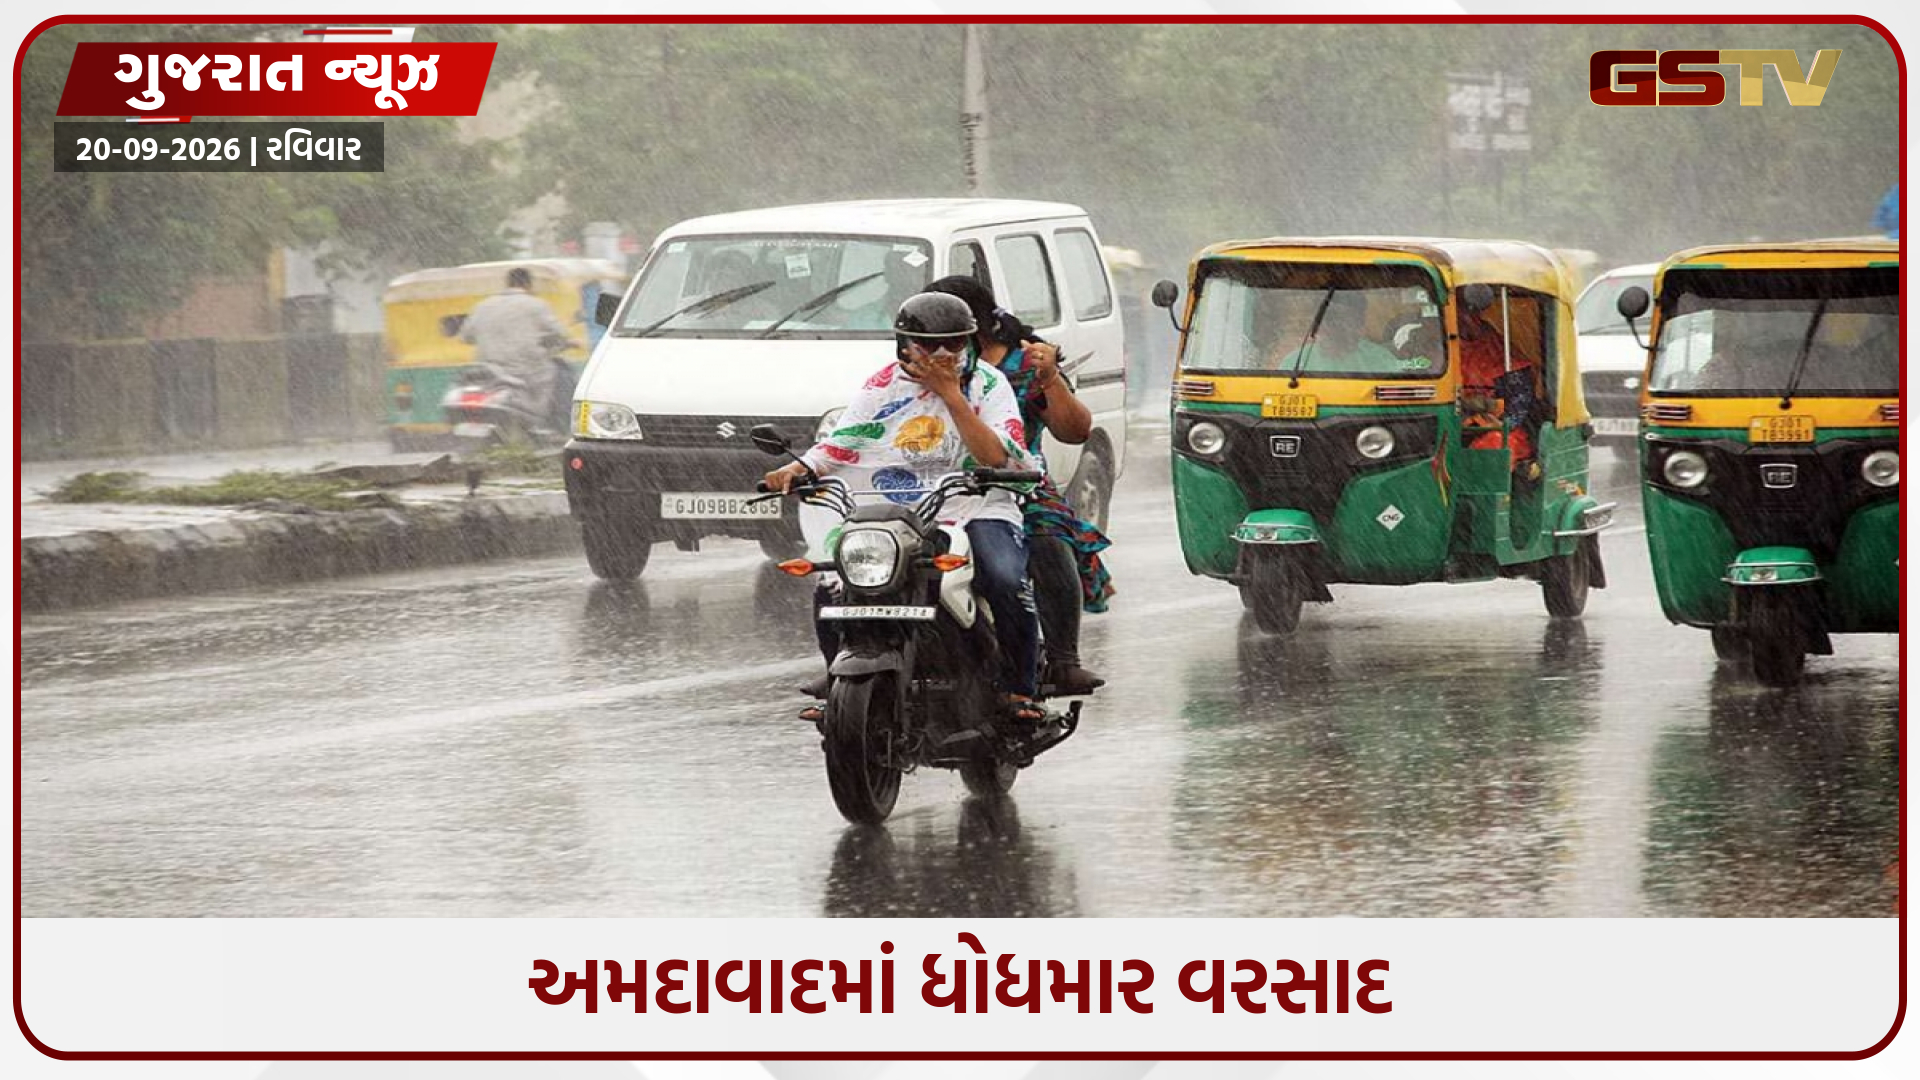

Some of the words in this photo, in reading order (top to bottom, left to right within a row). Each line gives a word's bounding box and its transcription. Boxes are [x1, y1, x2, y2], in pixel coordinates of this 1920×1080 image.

[1276, 442, 1295, 454] RE
[1767, 471, 1792, 484] RE
[1382, 513, 1400, 522] CNG
